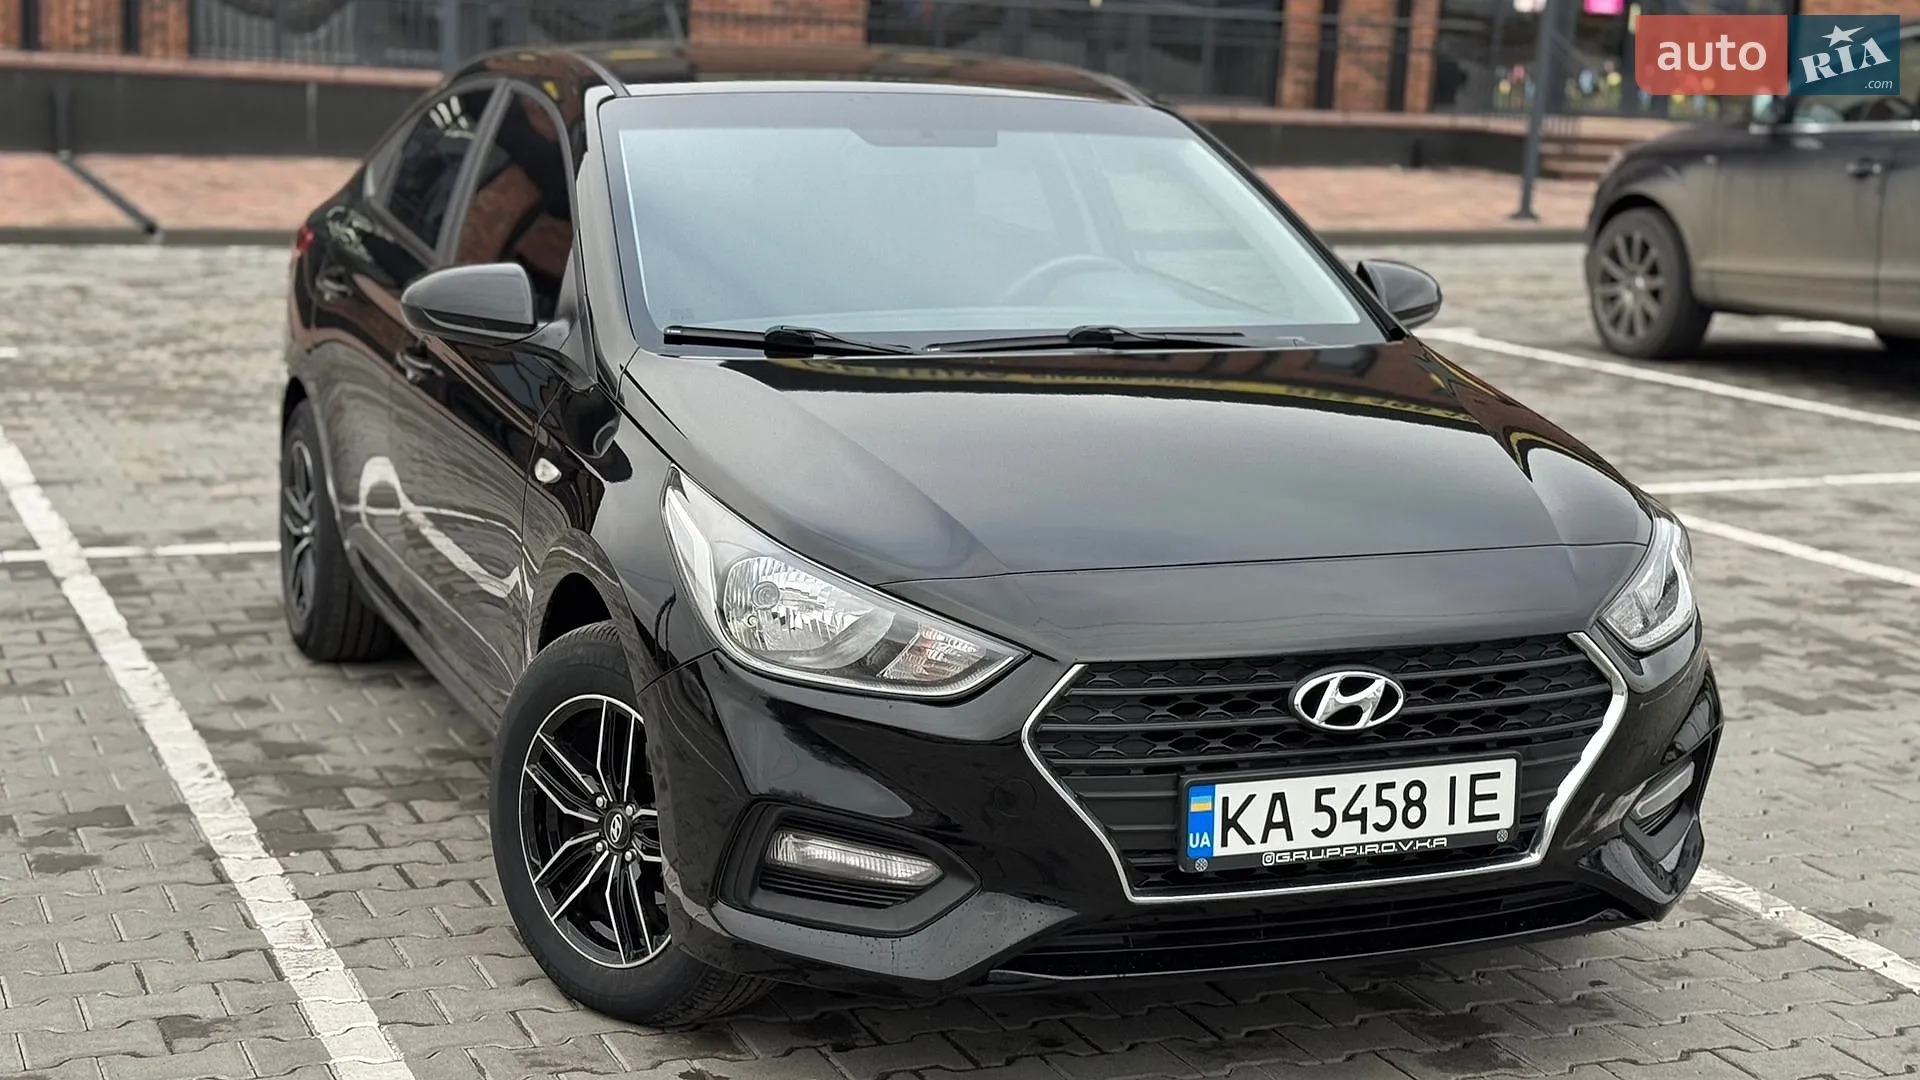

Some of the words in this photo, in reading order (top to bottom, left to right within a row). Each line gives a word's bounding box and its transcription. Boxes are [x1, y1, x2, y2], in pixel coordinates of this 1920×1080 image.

[1220, 791, 1294, 848] KA
[1310, 780, 1427, 838] 5458
[1448, 771, 1501, 826] IE
[1189, 831, 1211, 849] UA
